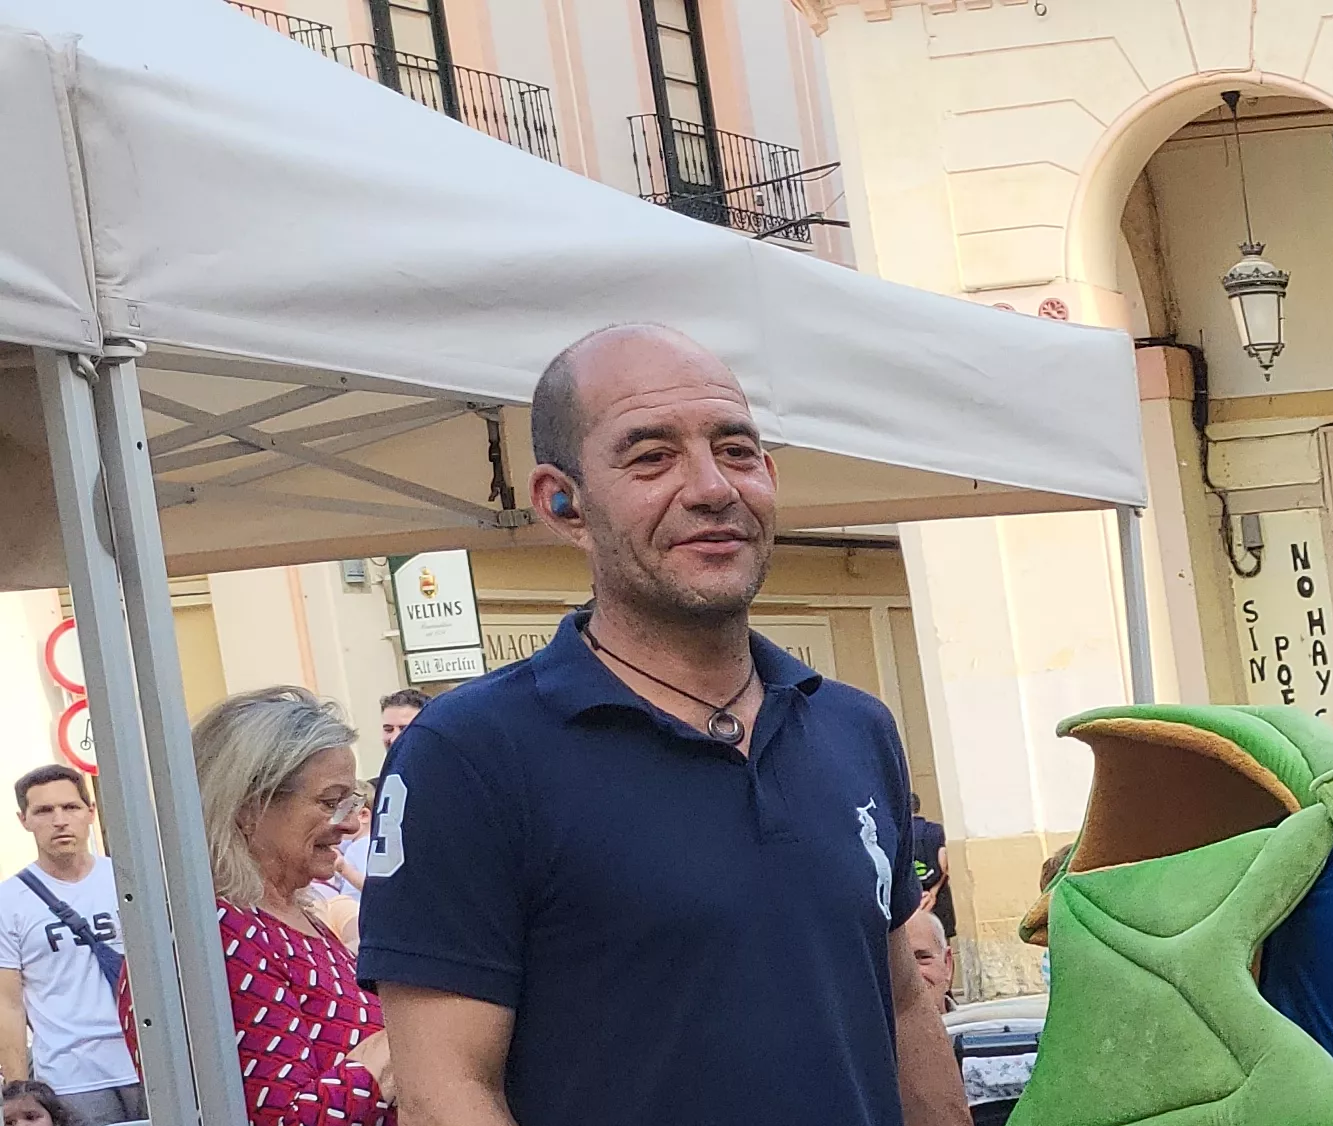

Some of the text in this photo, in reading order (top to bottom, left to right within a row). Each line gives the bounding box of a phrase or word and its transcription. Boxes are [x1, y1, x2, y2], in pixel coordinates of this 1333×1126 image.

[407, 601, 463, 620] VELTINS
[1243, 600, 1267, 684] SIN
[1291, 541, 1315, 598] NO
[1307, 608, 1330, 696] HAY
